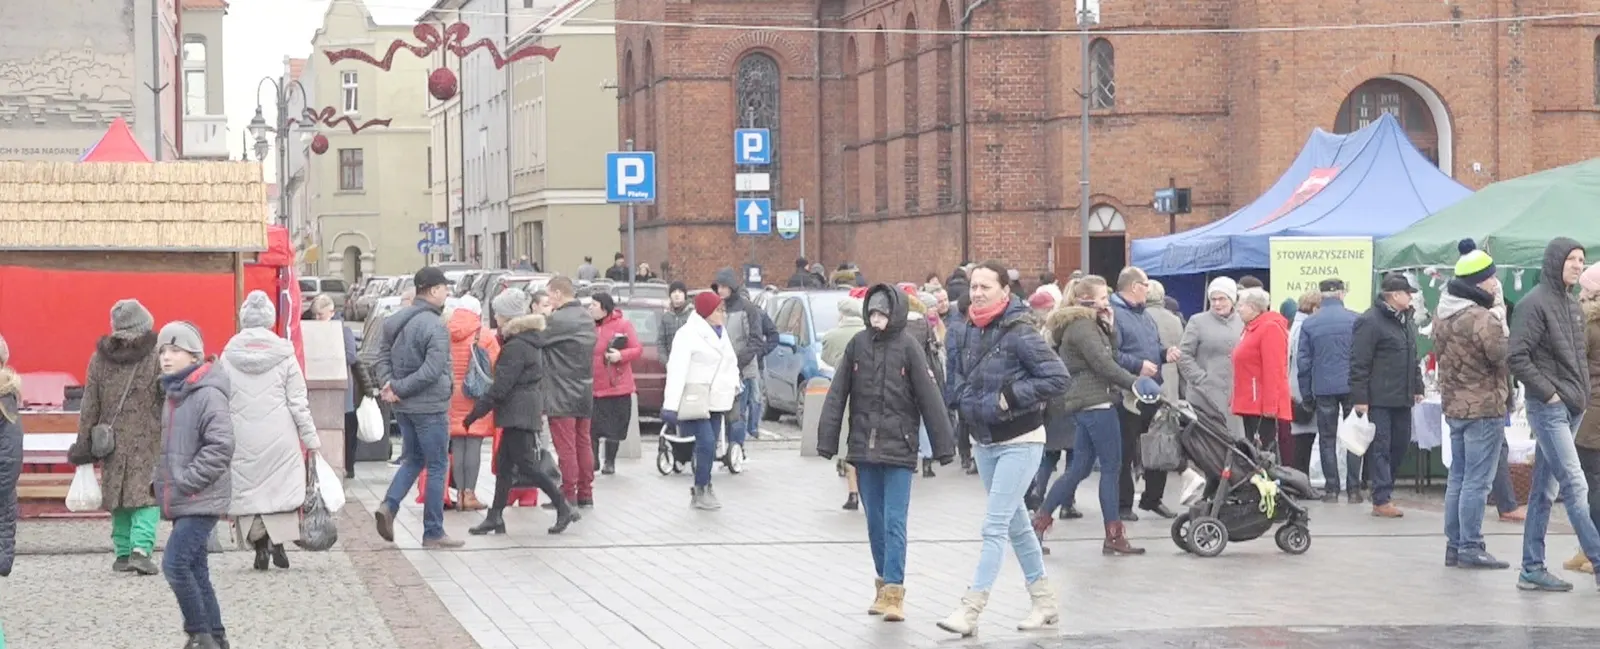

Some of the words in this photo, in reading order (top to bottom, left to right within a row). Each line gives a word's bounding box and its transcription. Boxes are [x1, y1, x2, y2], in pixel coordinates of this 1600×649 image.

[743, 133, 762, 160] P
[617, 157, 645, 196] P
[1277, 249, 1365, 260] STOWARZYSZENIE
[1300, 266, 1339, 275] SZANSA
[1286, 281, 1302, 291] NA
